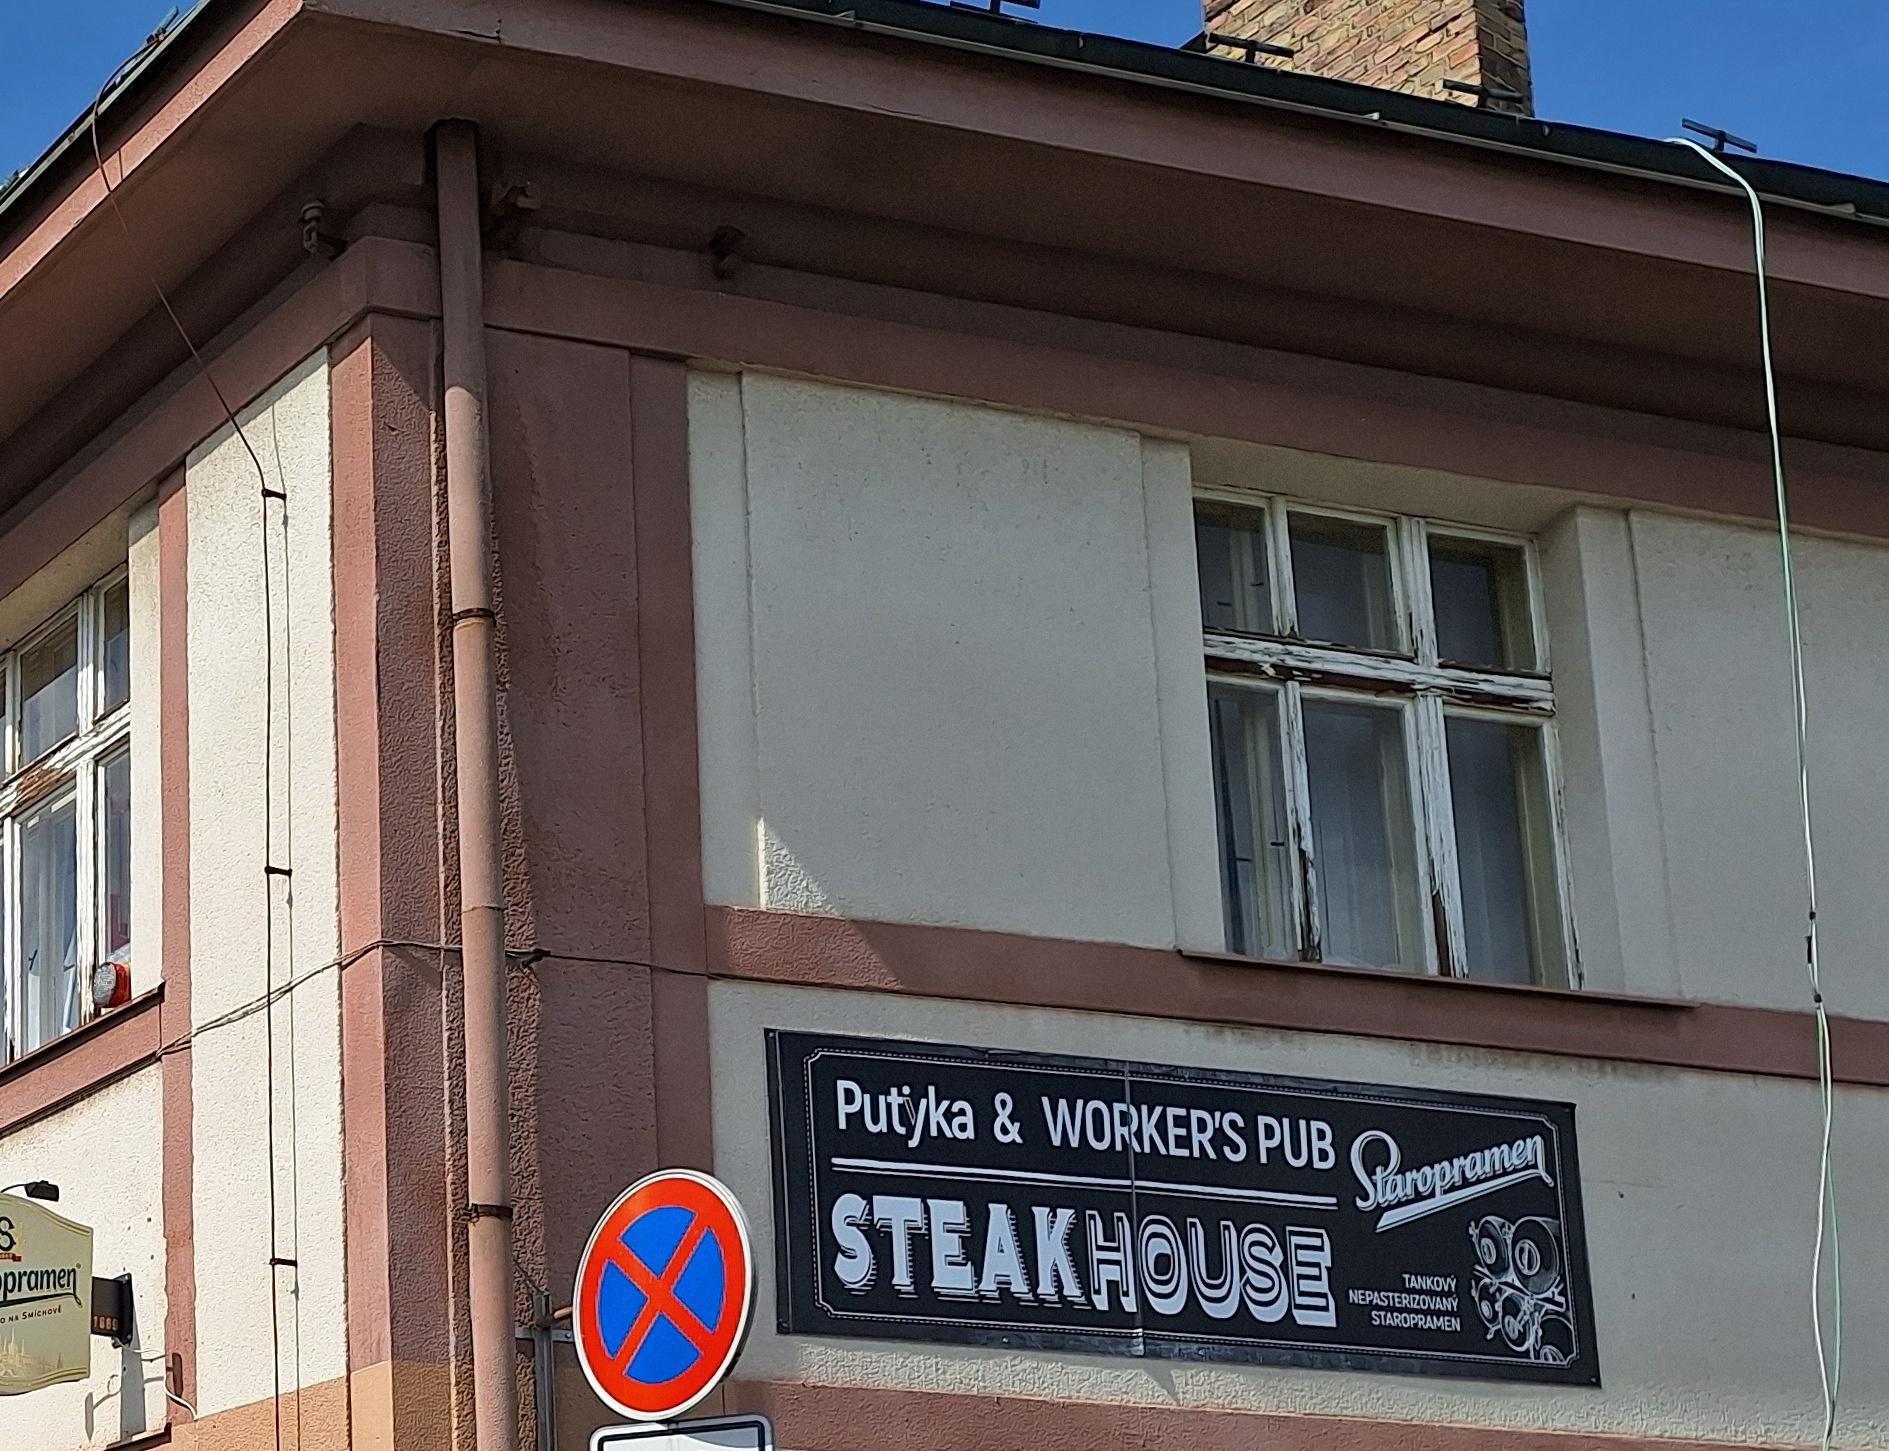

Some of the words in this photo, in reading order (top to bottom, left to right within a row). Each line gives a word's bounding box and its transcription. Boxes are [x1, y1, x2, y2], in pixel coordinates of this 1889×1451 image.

[994, 1091, 1023, 1144] &
[1042, 1093, 1246, 1163] WORKER'S
[1259, 1114, 1337, 1171] PUB
[1350, 1130, 1555, 1214] Staropramen
[1402, 1274, 1457, 1292] TANKOVÝ
[1349, 1289, 1459, 1312] NEPASTERIZOVANÝ
[1371, 1311, 1461, 1332] STAROPRAMEN
